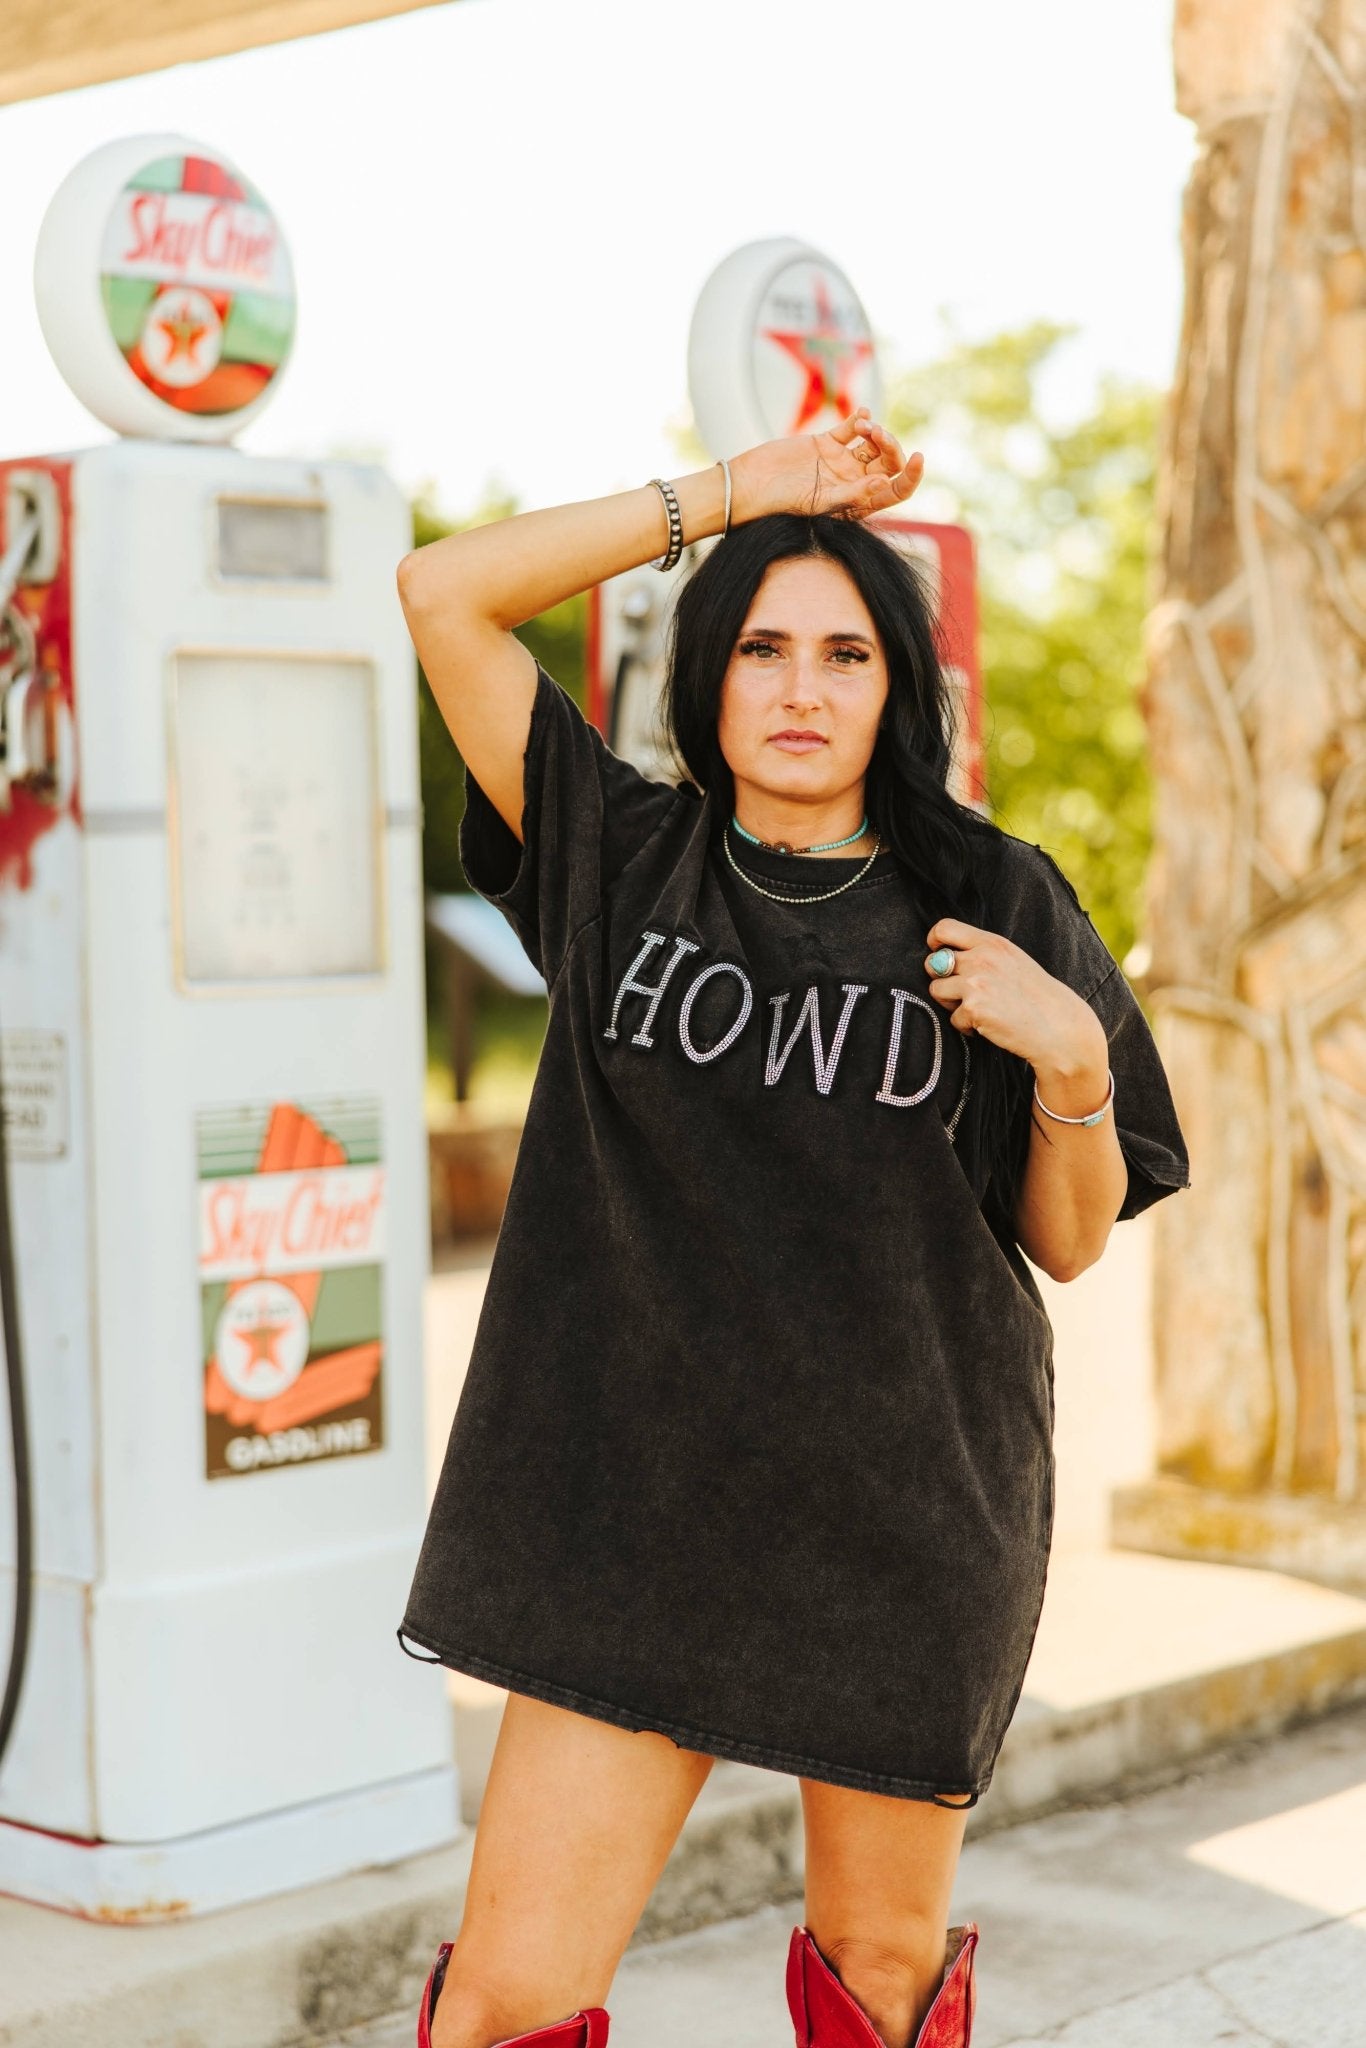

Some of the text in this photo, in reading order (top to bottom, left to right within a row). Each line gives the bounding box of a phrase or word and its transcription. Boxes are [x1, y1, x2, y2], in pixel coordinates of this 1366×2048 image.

[122, 192, 202, 280] Sky
[603, 930, 971, 1144] HOWD
[199, 1168, 387, 1272] Sky Chief
[225, 1417, 371, 1470] GASOLINE
